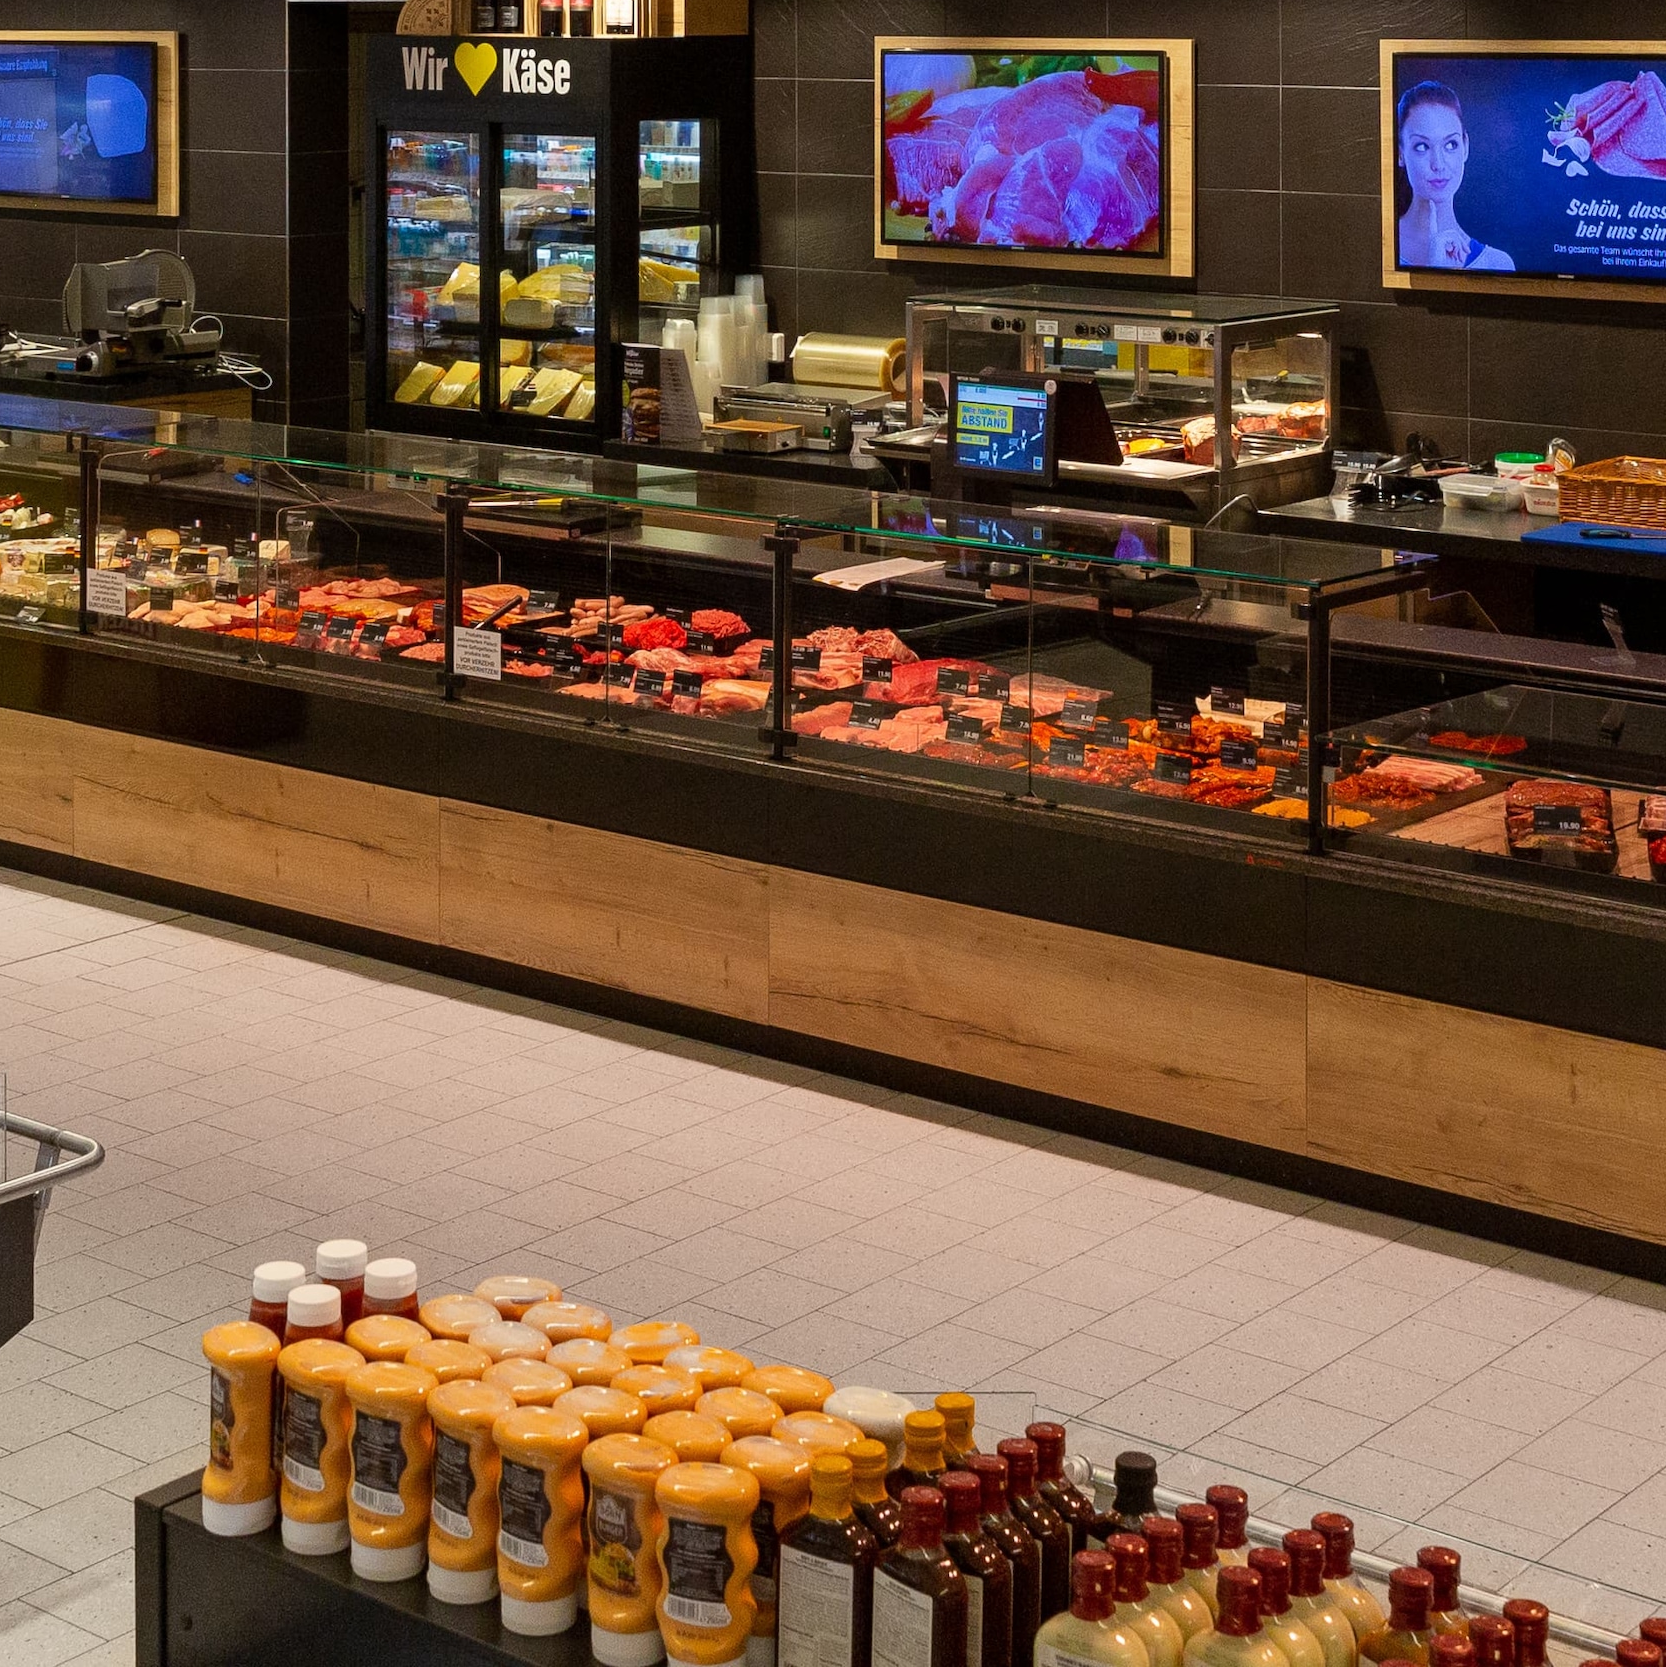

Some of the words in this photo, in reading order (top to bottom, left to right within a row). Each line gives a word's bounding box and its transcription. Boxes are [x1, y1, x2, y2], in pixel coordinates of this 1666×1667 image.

[402, 45, 449, 92] Wir
[502, 47, 572, 95] Käse
[1566, 198, 1622, 220] Schön,
[1575, 220, 1604, 239] bei
[1606, 225, 1638, 240] uns
[1553, 243, 1567, 253] Das
[1568, 245, 1599, 256] gesamte
[1600, 245, 1621, 256] Team
[1622, 246, 1653, 257] wünscht
[1602, 256, 1614, 266] bei
[1615, 257, 1637, 267] Ihrem
[961, 415, 1008, 429] ABSTAND
